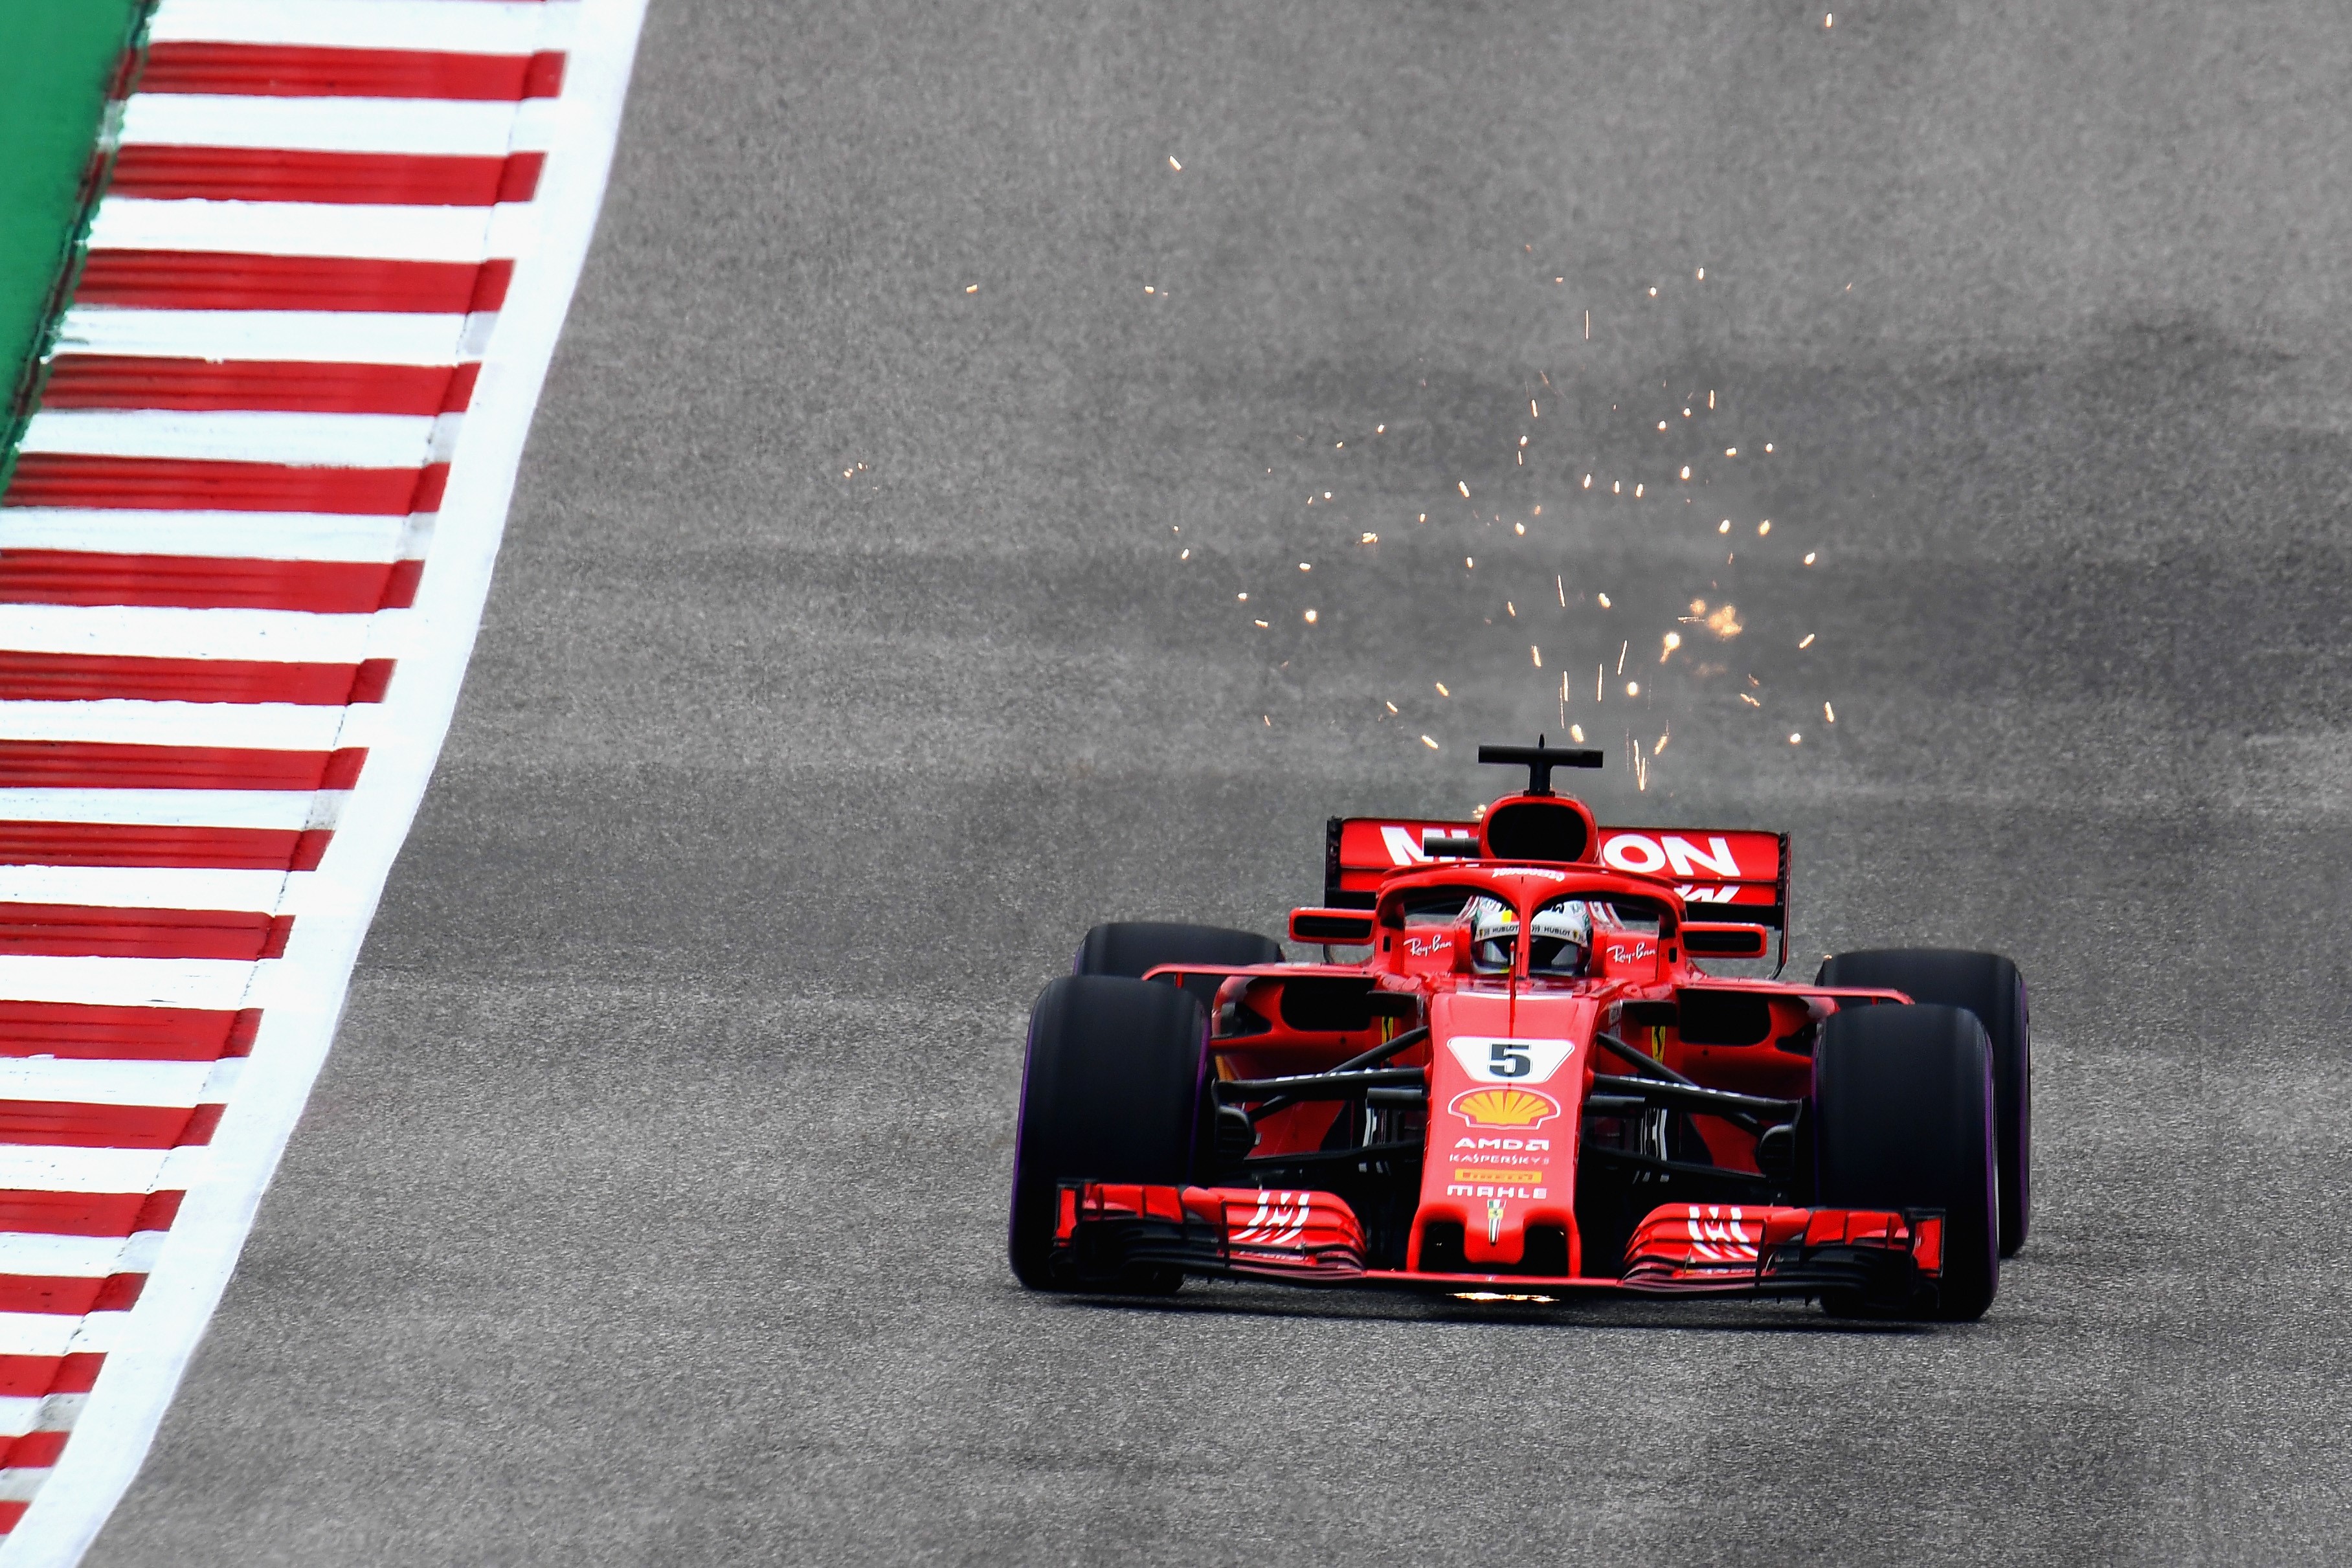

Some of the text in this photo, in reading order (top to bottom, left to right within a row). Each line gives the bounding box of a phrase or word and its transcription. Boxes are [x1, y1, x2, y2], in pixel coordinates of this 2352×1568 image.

[1543, 926, 1571, 937] HUBLOT
[1488, 1042, 1532, 1078] 5
[1454, 1137, 1524, 1150] AMD
[1448, 1152, 1541, 1165] KASPERSKY
[1446, 1184, 1547, 1199] MAHLE
